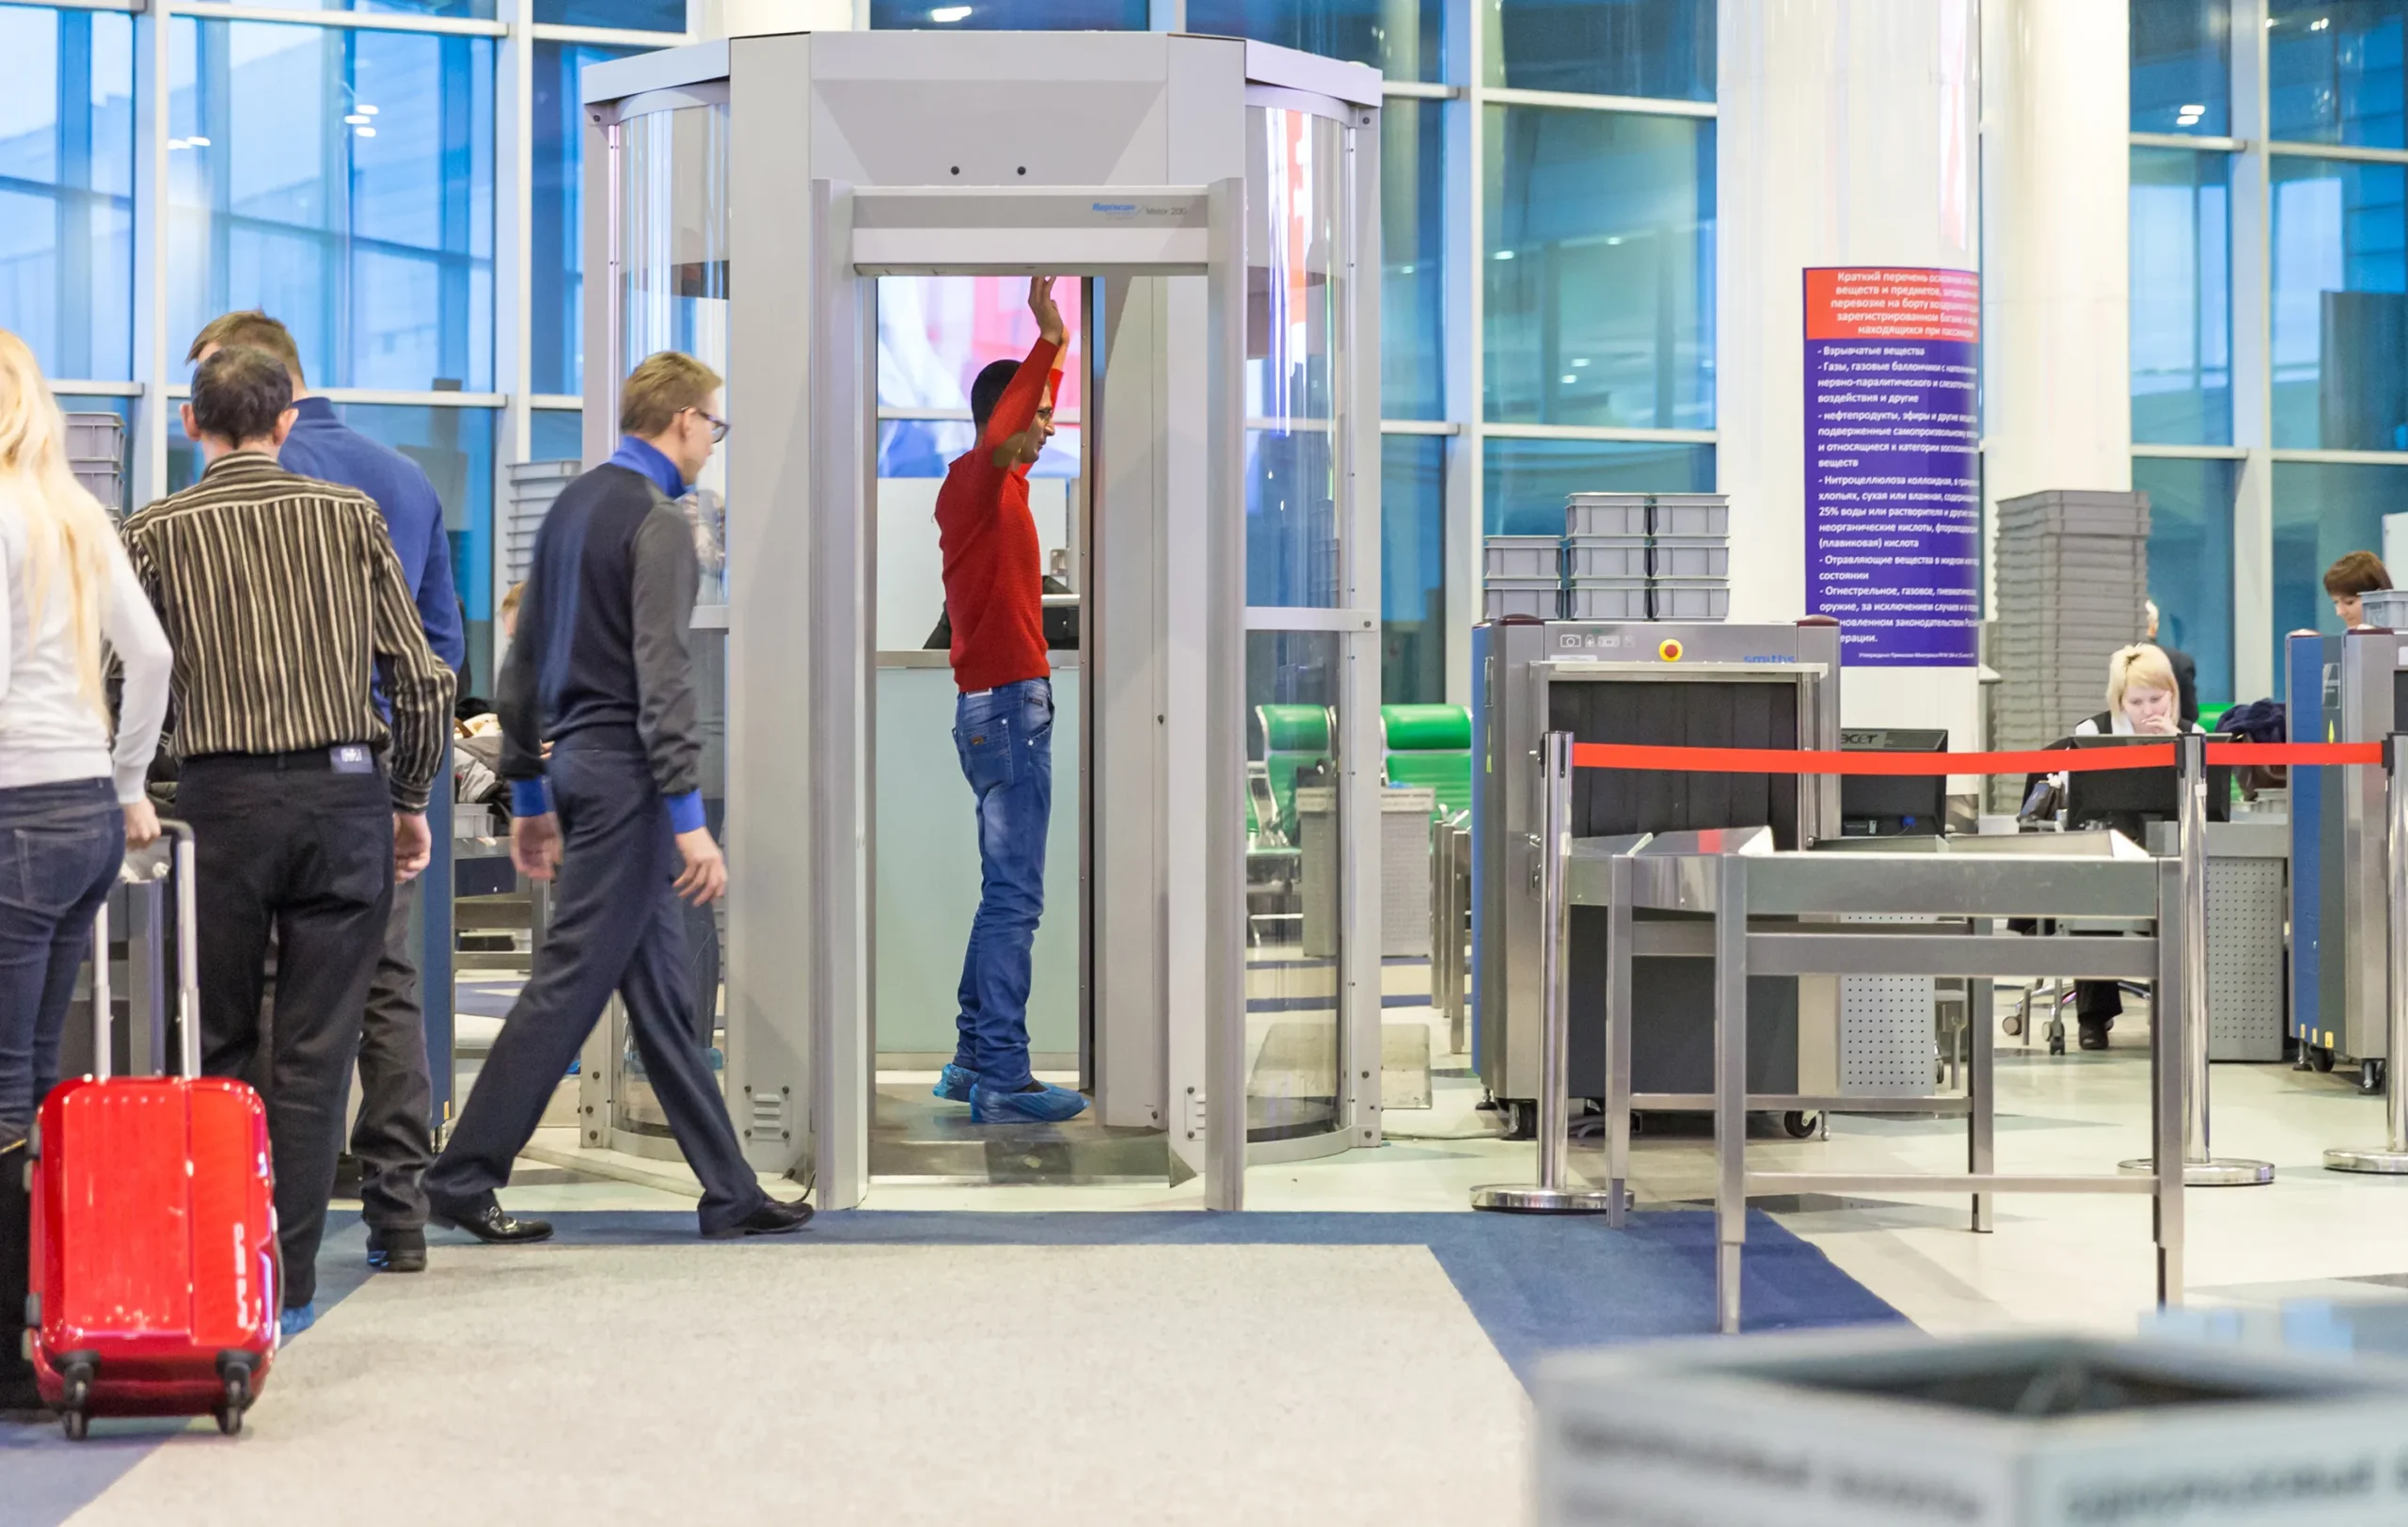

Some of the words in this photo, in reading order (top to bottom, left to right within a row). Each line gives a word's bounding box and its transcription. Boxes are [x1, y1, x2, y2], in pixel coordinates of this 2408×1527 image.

[1837, 271, 1880, 283] Краткий
[1883, 273, 1927, 283] перечень
[1836, 286, 1879, 296] веществ
[1881, 286, 1889, 294] и
[1891, 286, 1943, 297] предметов,
[1888, 300, 1900, 309] на
[1902, 297, 1929, 310] борту
[1836, 312, 1940, 324] зарегистрированном
[1858, 326, 1924, 337] находящихся
[1925, 327, 1941, 338] при
[1823, 346, 1882, 358] Взрывчатые
[1883, 347, 1925, 357] вещества
[1823, 362, 1849, 373] Газы,
[1851, 363, 1891, 372] газовые
[1892, 361, 1941, 373] баллончики
[1817, 379, 1932, 389] нервно-паралитического
[1817, 392, 1879, 405] воздействия
[1880, 394, 1887, 403] и
[1888, 395, 1920, 405] другие
[1823, 410, 1901, 422] нефтепродукты,
[1902, 410, 1930, 422] эфиры
[1817, 428, 1893, 437] подверженные
[1826, 443, 1890, 453] относящиеся
[1898, 444, 1940, 453] категории
[1817, 459, 1859, 469] веществ
[1824, 475, 1906, 486] Нитроцеллюлоза
[1817, 492, 1861, 501] хлопьях,
[1861, 492, 1888, 502] сухая
[1818, 506, 1840, 517] 25%
[1841, 508, 1867, 518] воды
[1868, 508, 1887, 517] или
[1818, 524, 1896, 534] неорганические
[1897, 524, 1935, 534] кислоты,
[1818, 537, 1882, 549] (плавиковая)
[1883, 539, 1920, 548] кислота
[1825, 554, 1893, 566] Отравляющие
[1894, 556, 1934, 566] вещества
[1818, 572, 1870, 581] состоянии
[1825, 585, 1900, 597] Огнестрельное,
[1901, 587, 1936, 597] газовое,
[1818, 603, 1861, 613] оружие,
[1861, 603, 1873, 612] за
[1840, 619, 1893, 628] новленном
[1840, 635, 1878, 644] ерации.
